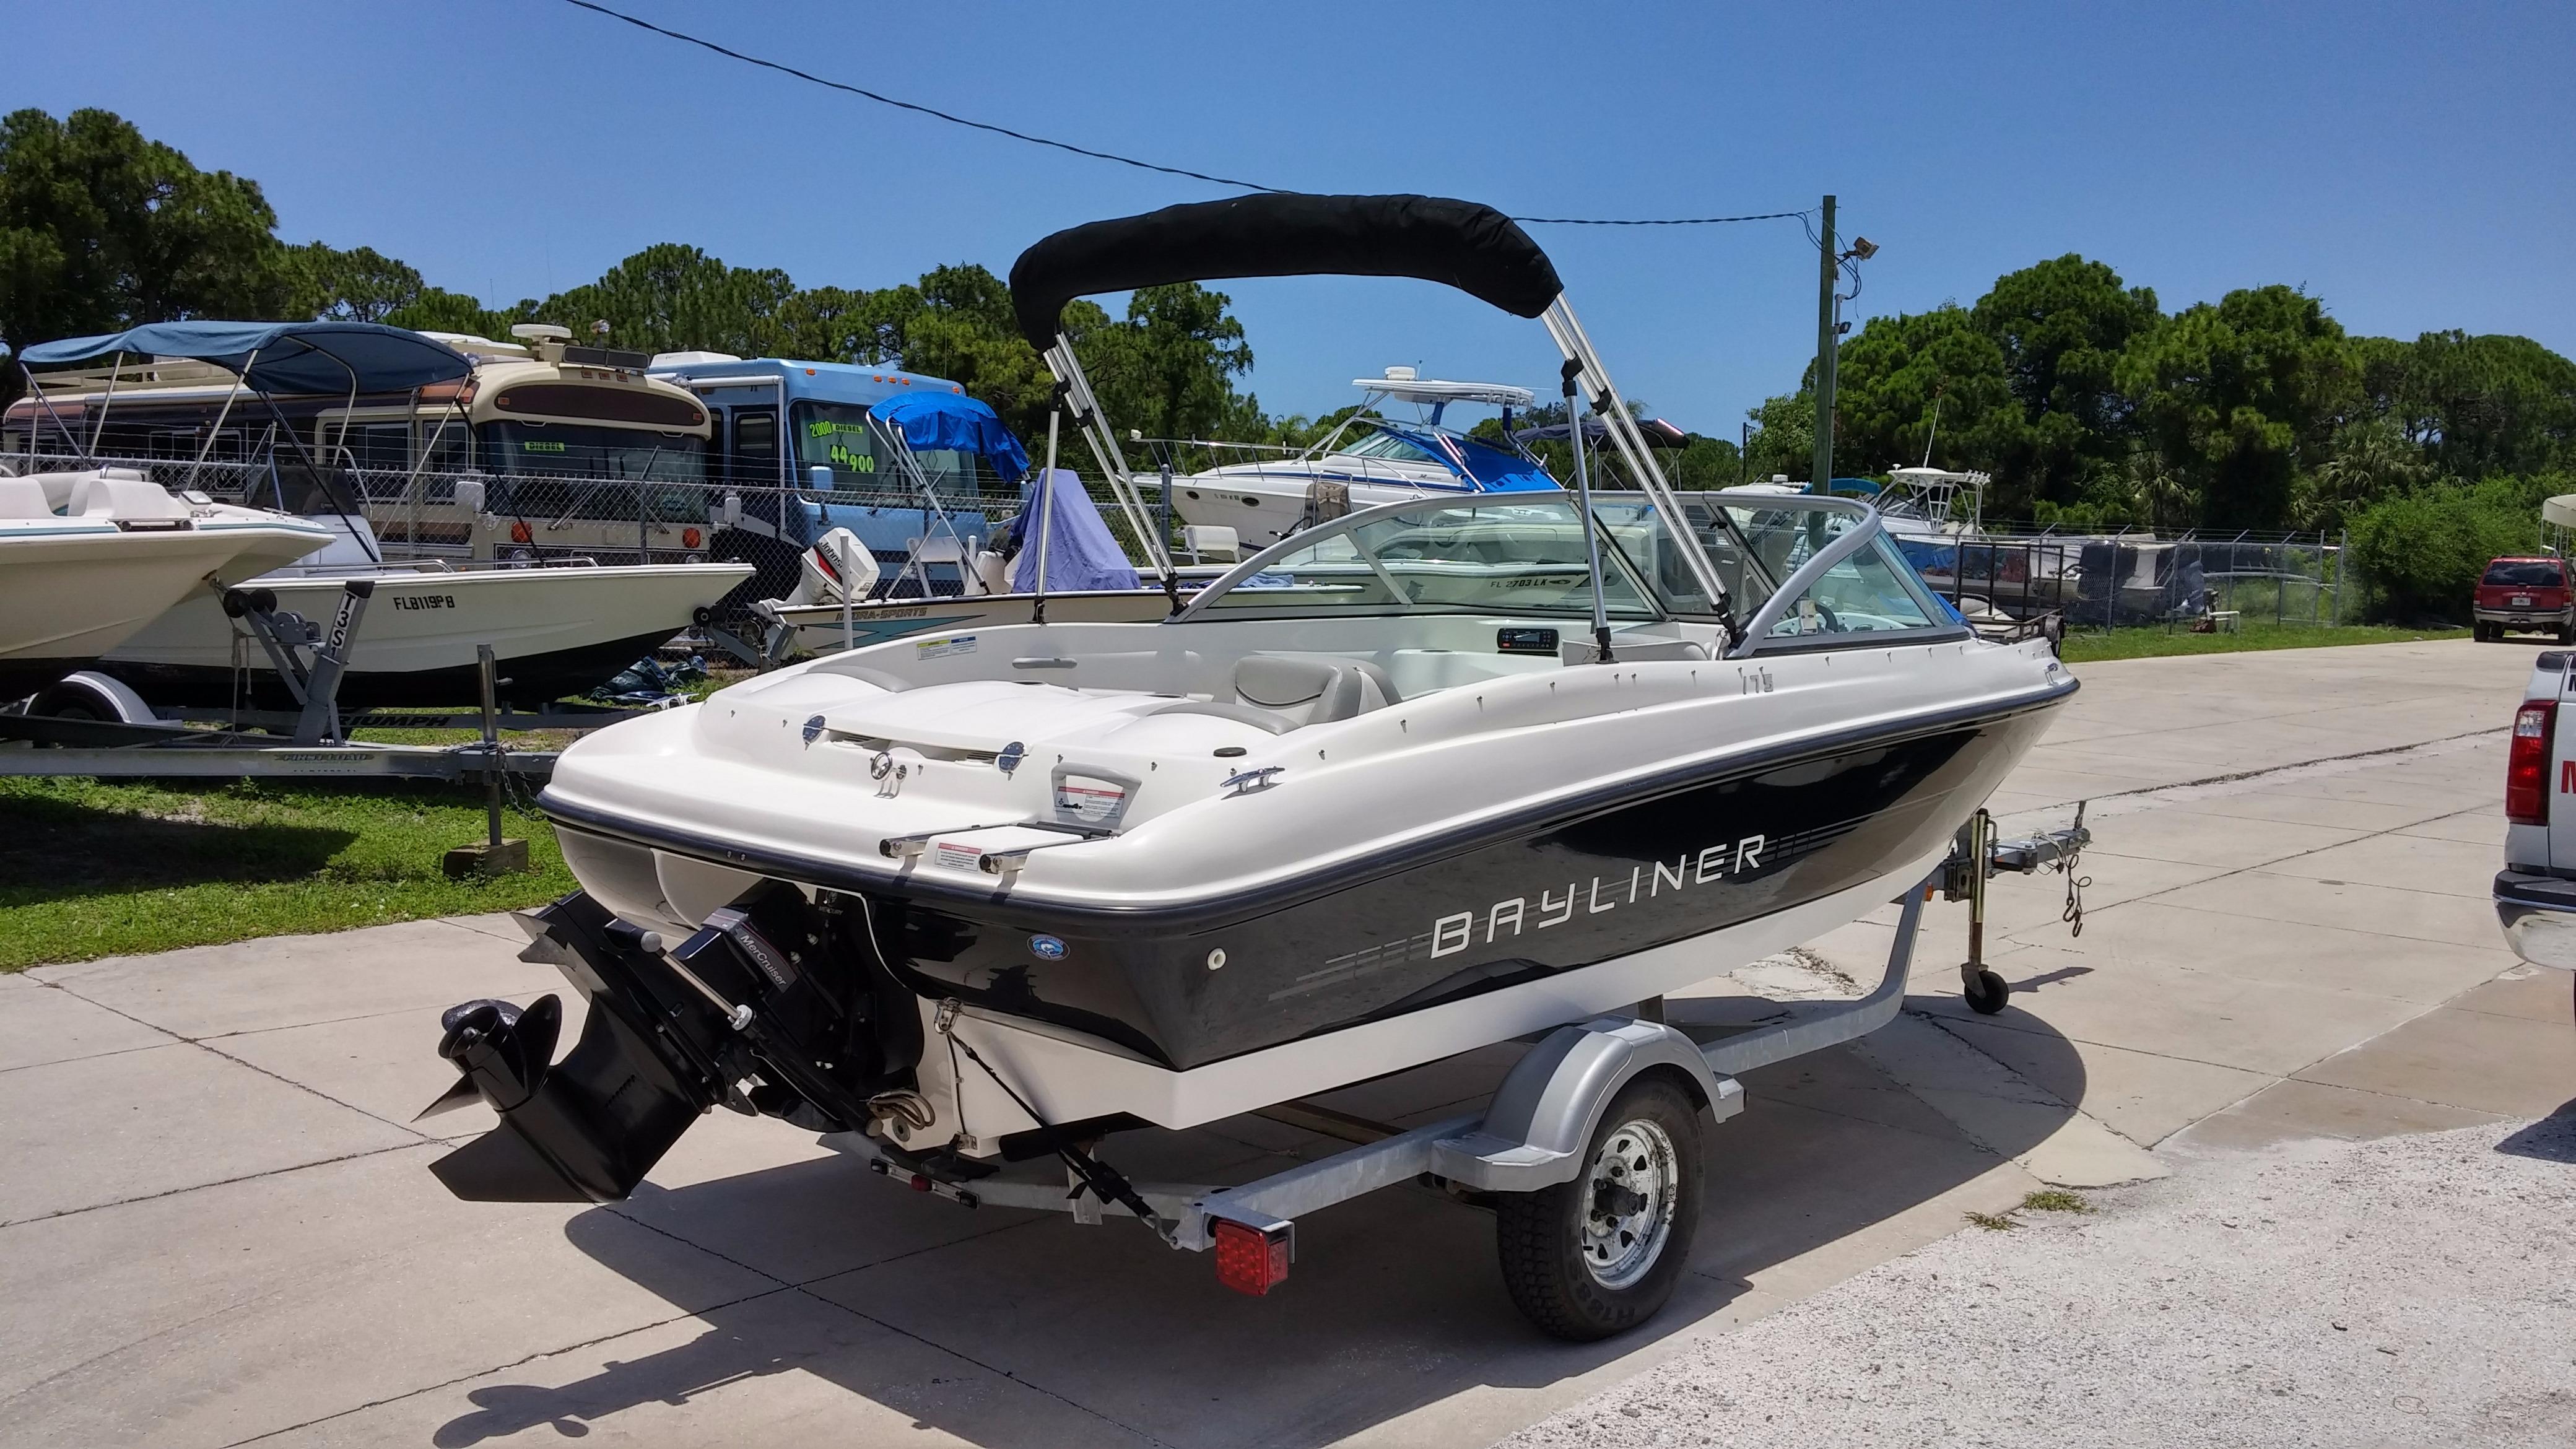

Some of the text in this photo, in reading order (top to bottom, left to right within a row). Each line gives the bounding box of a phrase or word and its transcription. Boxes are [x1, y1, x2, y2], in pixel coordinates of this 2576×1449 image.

[809, 420, 832, 438] 2000
[529, 442, 562, 450] DIESEL
[820, 542, 843, 569] Johns
[1505, 579, 1532, 588] 2703
[1533, 578, 1548, 586] LK
[835, 607, 928, 621] HDRA-SPORTS
[338, 716, 451, 726] RIUMPH
[1430, 834, 1765, 959] BAYLINER
[740, 934, 786, 986] MerCruiser
